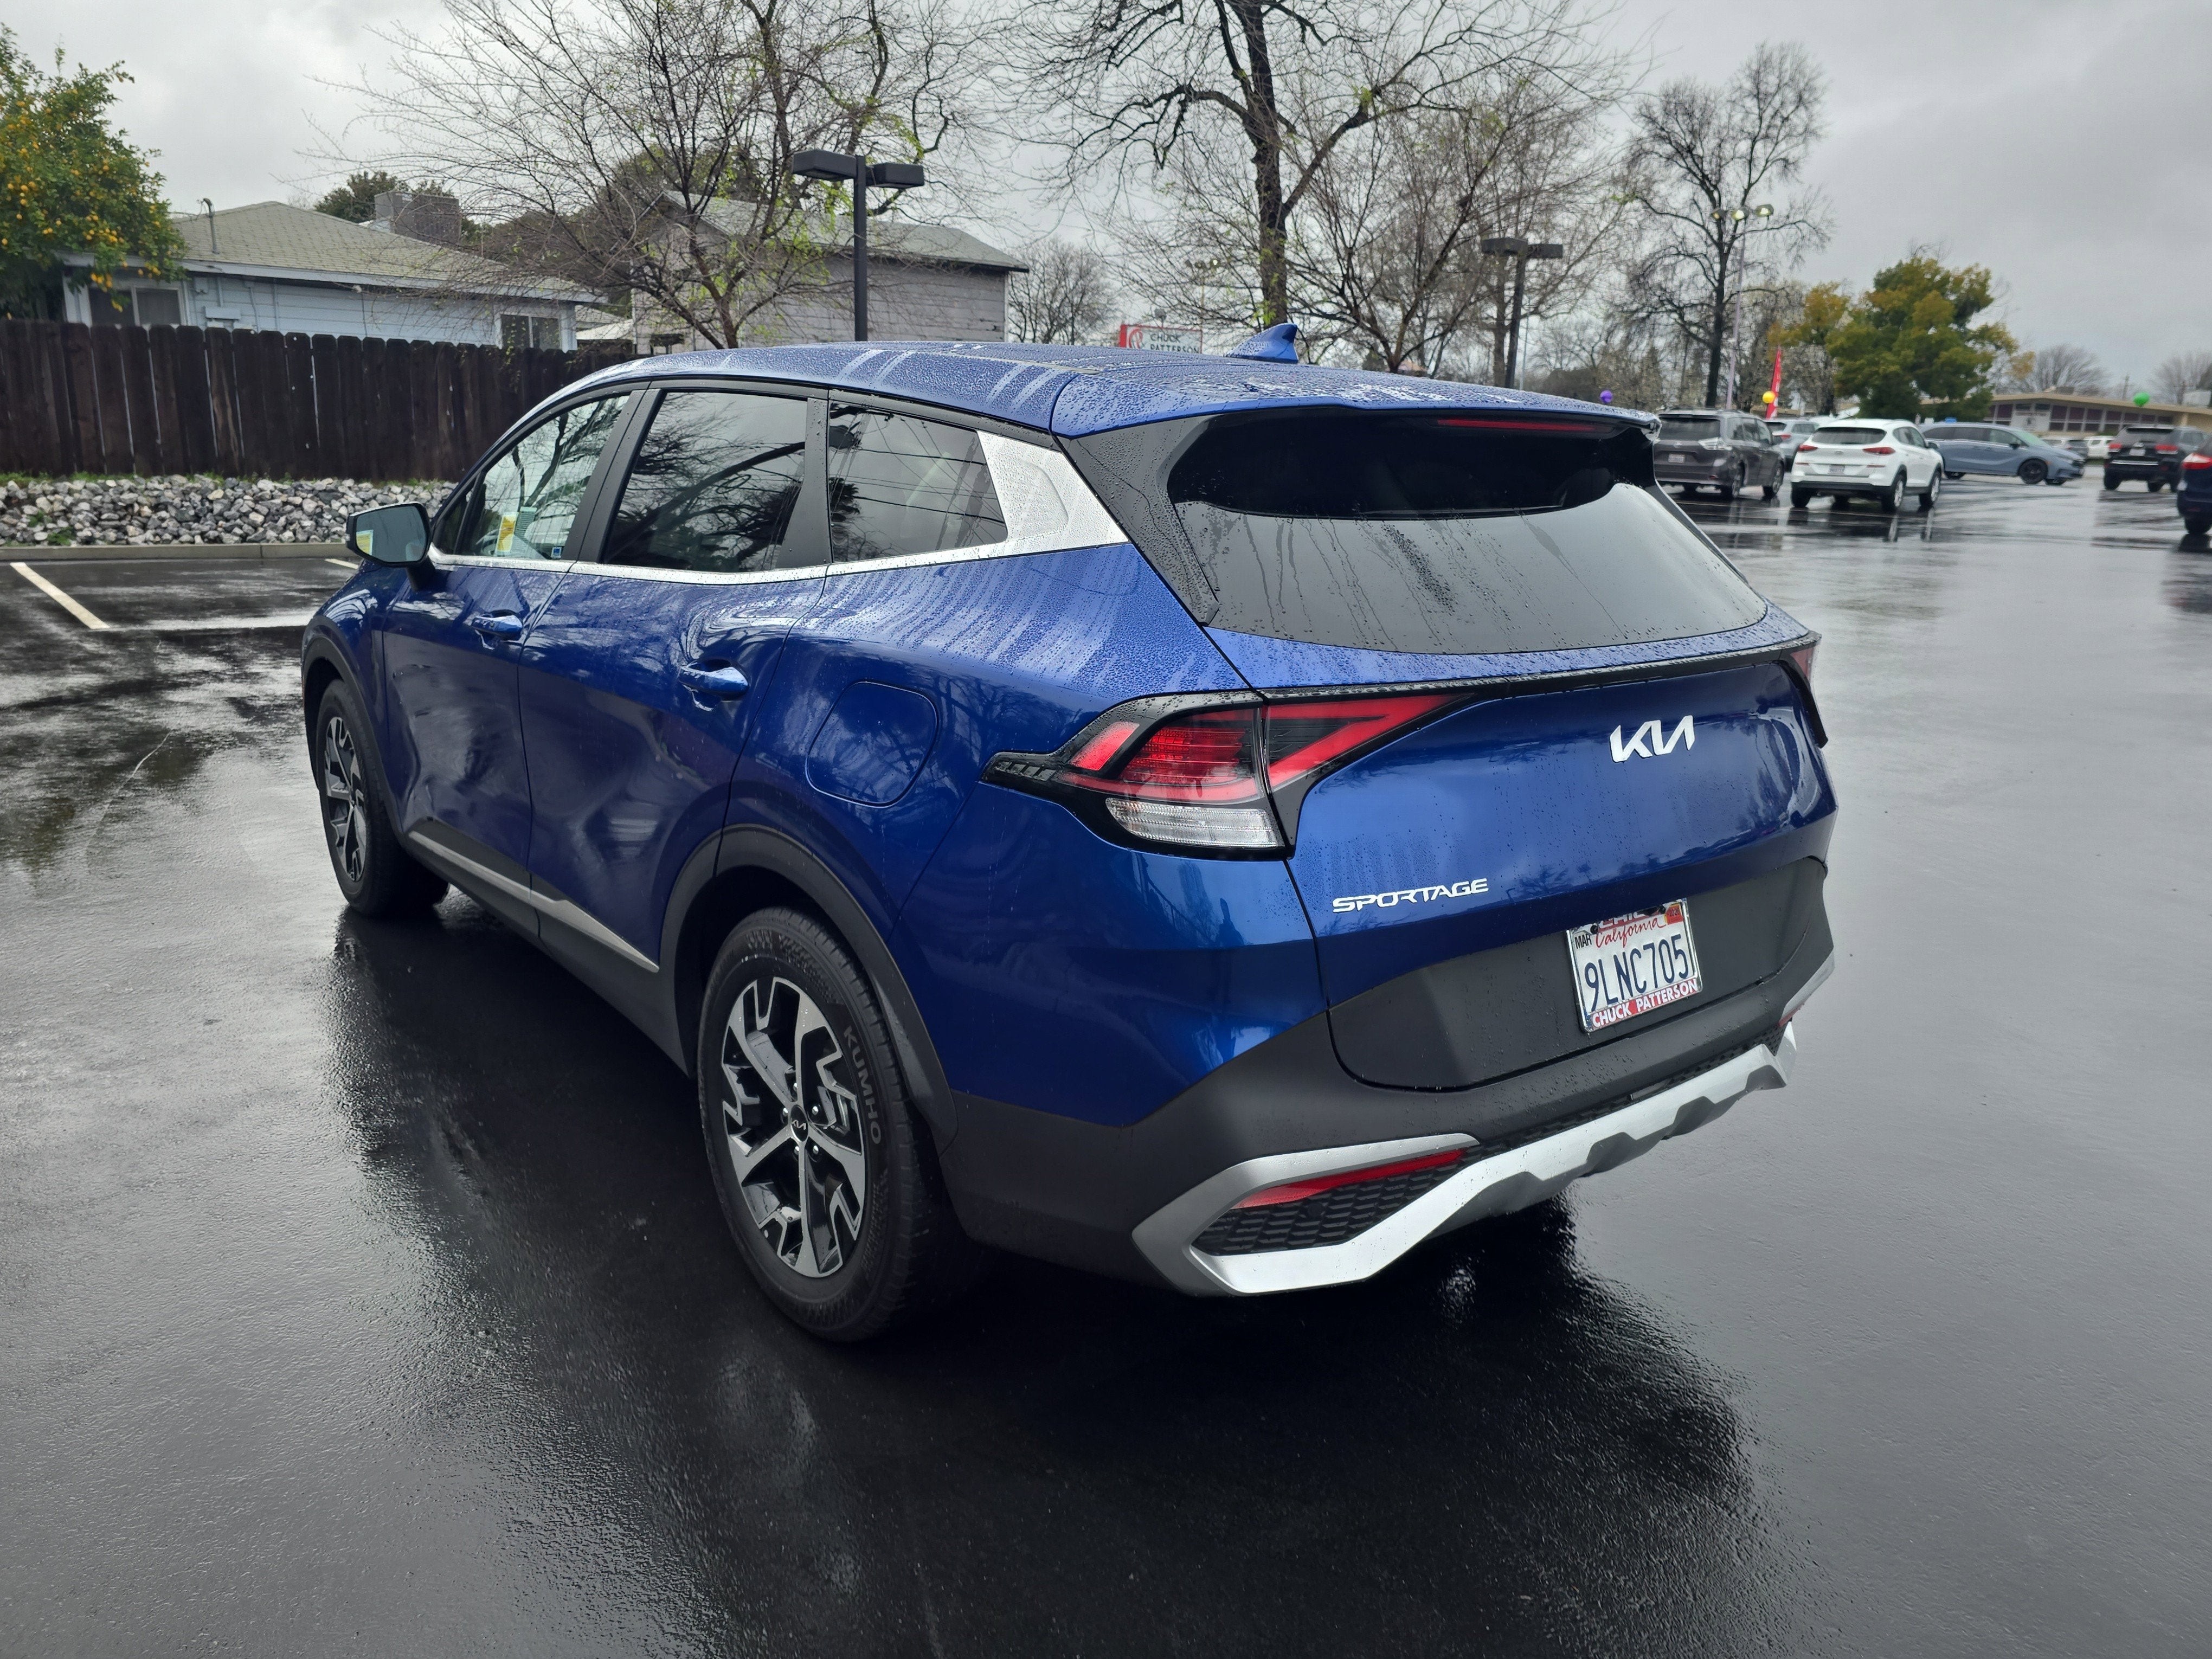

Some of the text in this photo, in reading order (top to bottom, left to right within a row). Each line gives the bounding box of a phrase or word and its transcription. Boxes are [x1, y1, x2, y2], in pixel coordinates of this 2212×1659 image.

[1150, 333, 1181, 343] CHUCK
[1150, 344, 1200, 352] PATTERSON
[1610, 715, 1695, 763] KIA
[1332, 878, 1489, 912] SPORTAGE
[1574, 934, 1592, 949] MAR
[1595, 917, 1667, 948] California
[1584, 934, 1689, 1012] 9LNC705
[1591, 979, 1697, 1027] CHUCK PATTERSON
[844, 1025, 882, 1144] KUMHO
